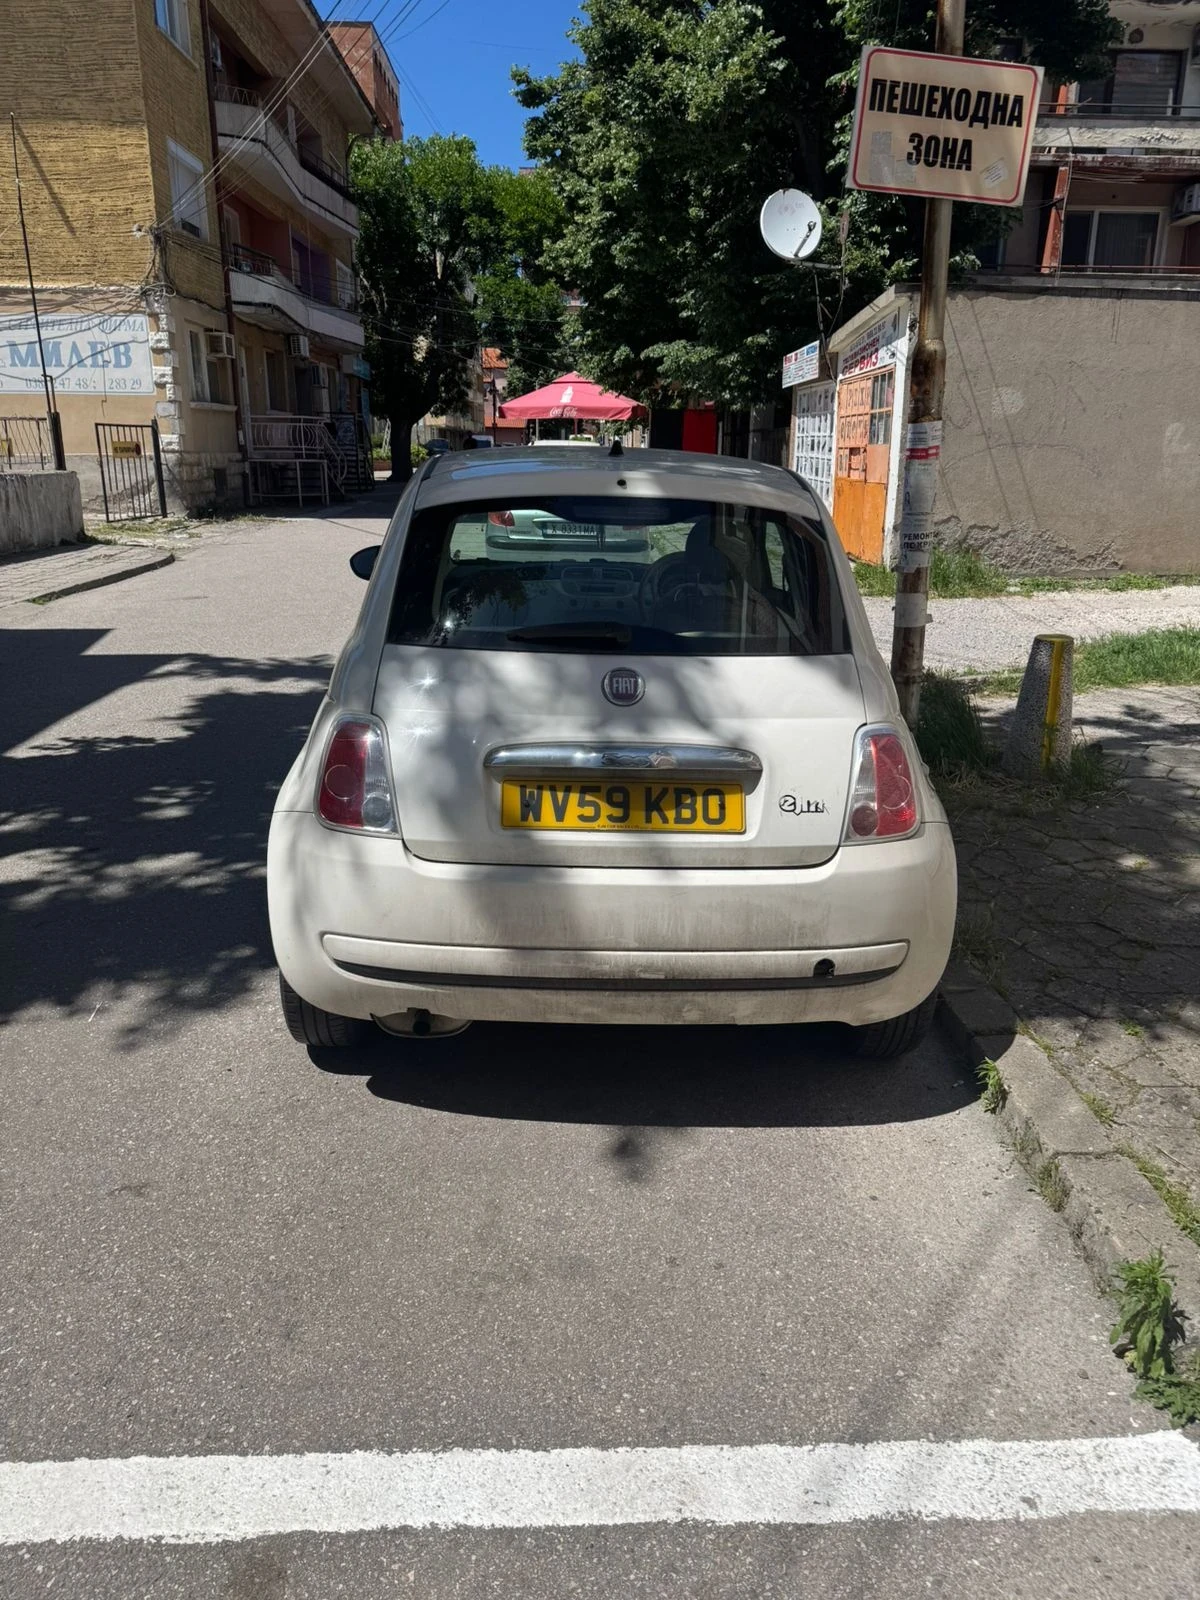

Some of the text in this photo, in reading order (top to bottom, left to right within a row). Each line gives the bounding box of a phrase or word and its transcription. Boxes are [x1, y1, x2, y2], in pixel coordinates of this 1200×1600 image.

[868, 78, 1024, 130] ПЕШЕХОДНА
[906, 132, 973, 171] ЗОНА
[7, 340, 133, 368] МИЛЕВ
[841, 347, 879, 377] СЕРВИЗ
[612, 676, 636, 695] FIAT
[519, 784, 726, 825] WV59 KBO
